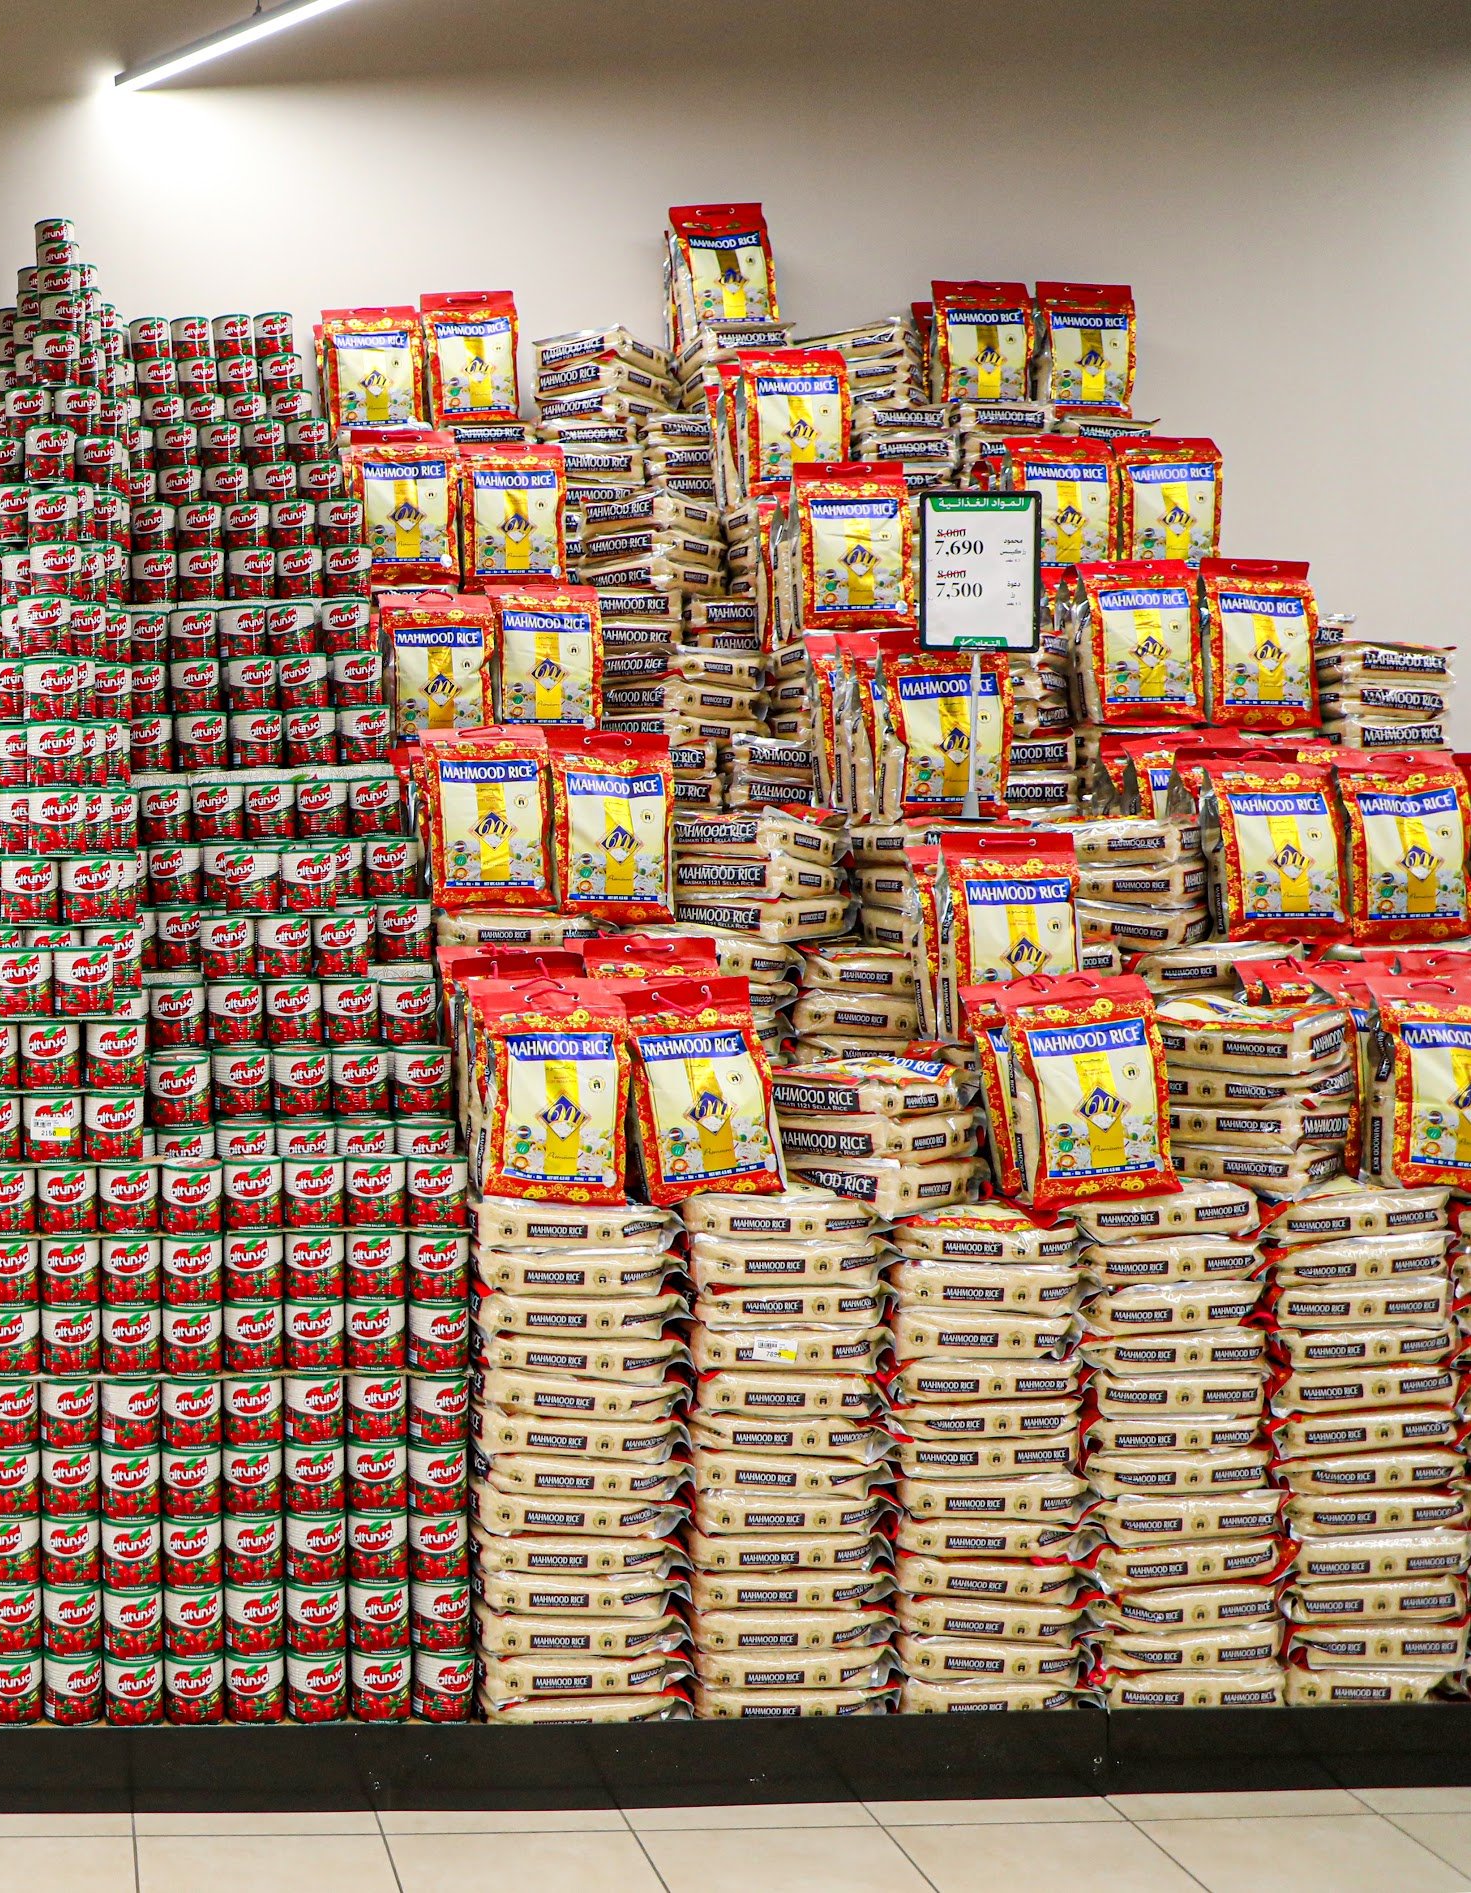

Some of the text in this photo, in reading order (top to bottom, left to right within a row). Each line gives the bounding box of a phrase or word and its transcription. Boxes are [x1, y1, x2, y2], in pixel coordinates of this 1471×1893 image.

[689, 234, 757, 250] MAHMOOD RICE
[437, 320, 506, 338] MAHMOOD RICE
[336, 334, 406, 348] MAHMOOD RICE
[939, 498, 1024, 510] المواد الغذائية
[935, 540, 984, 557] 7,690
[936, 582, 983, 599] 7,500
[505, 614, 585, 630] MAHMOOD RICE
[442, 766, 533, 781] MAHMOOD RICE
[678, 868, 760, 880] MAHMOOD RICE
[970, 884, 1067, 903] MAHMOOD RICE
[1032, 1026, 1140, 1052] MAHMOOD RICE
[773, 1088, 854, 1106] AHMOOD RICE
[232, 1175, 272, 1194] altunsa
[1308, 1345, 1361, 1355] MAHMOOD RICE
[740, 1591, 793, 1600] MAHMOOD RICE
